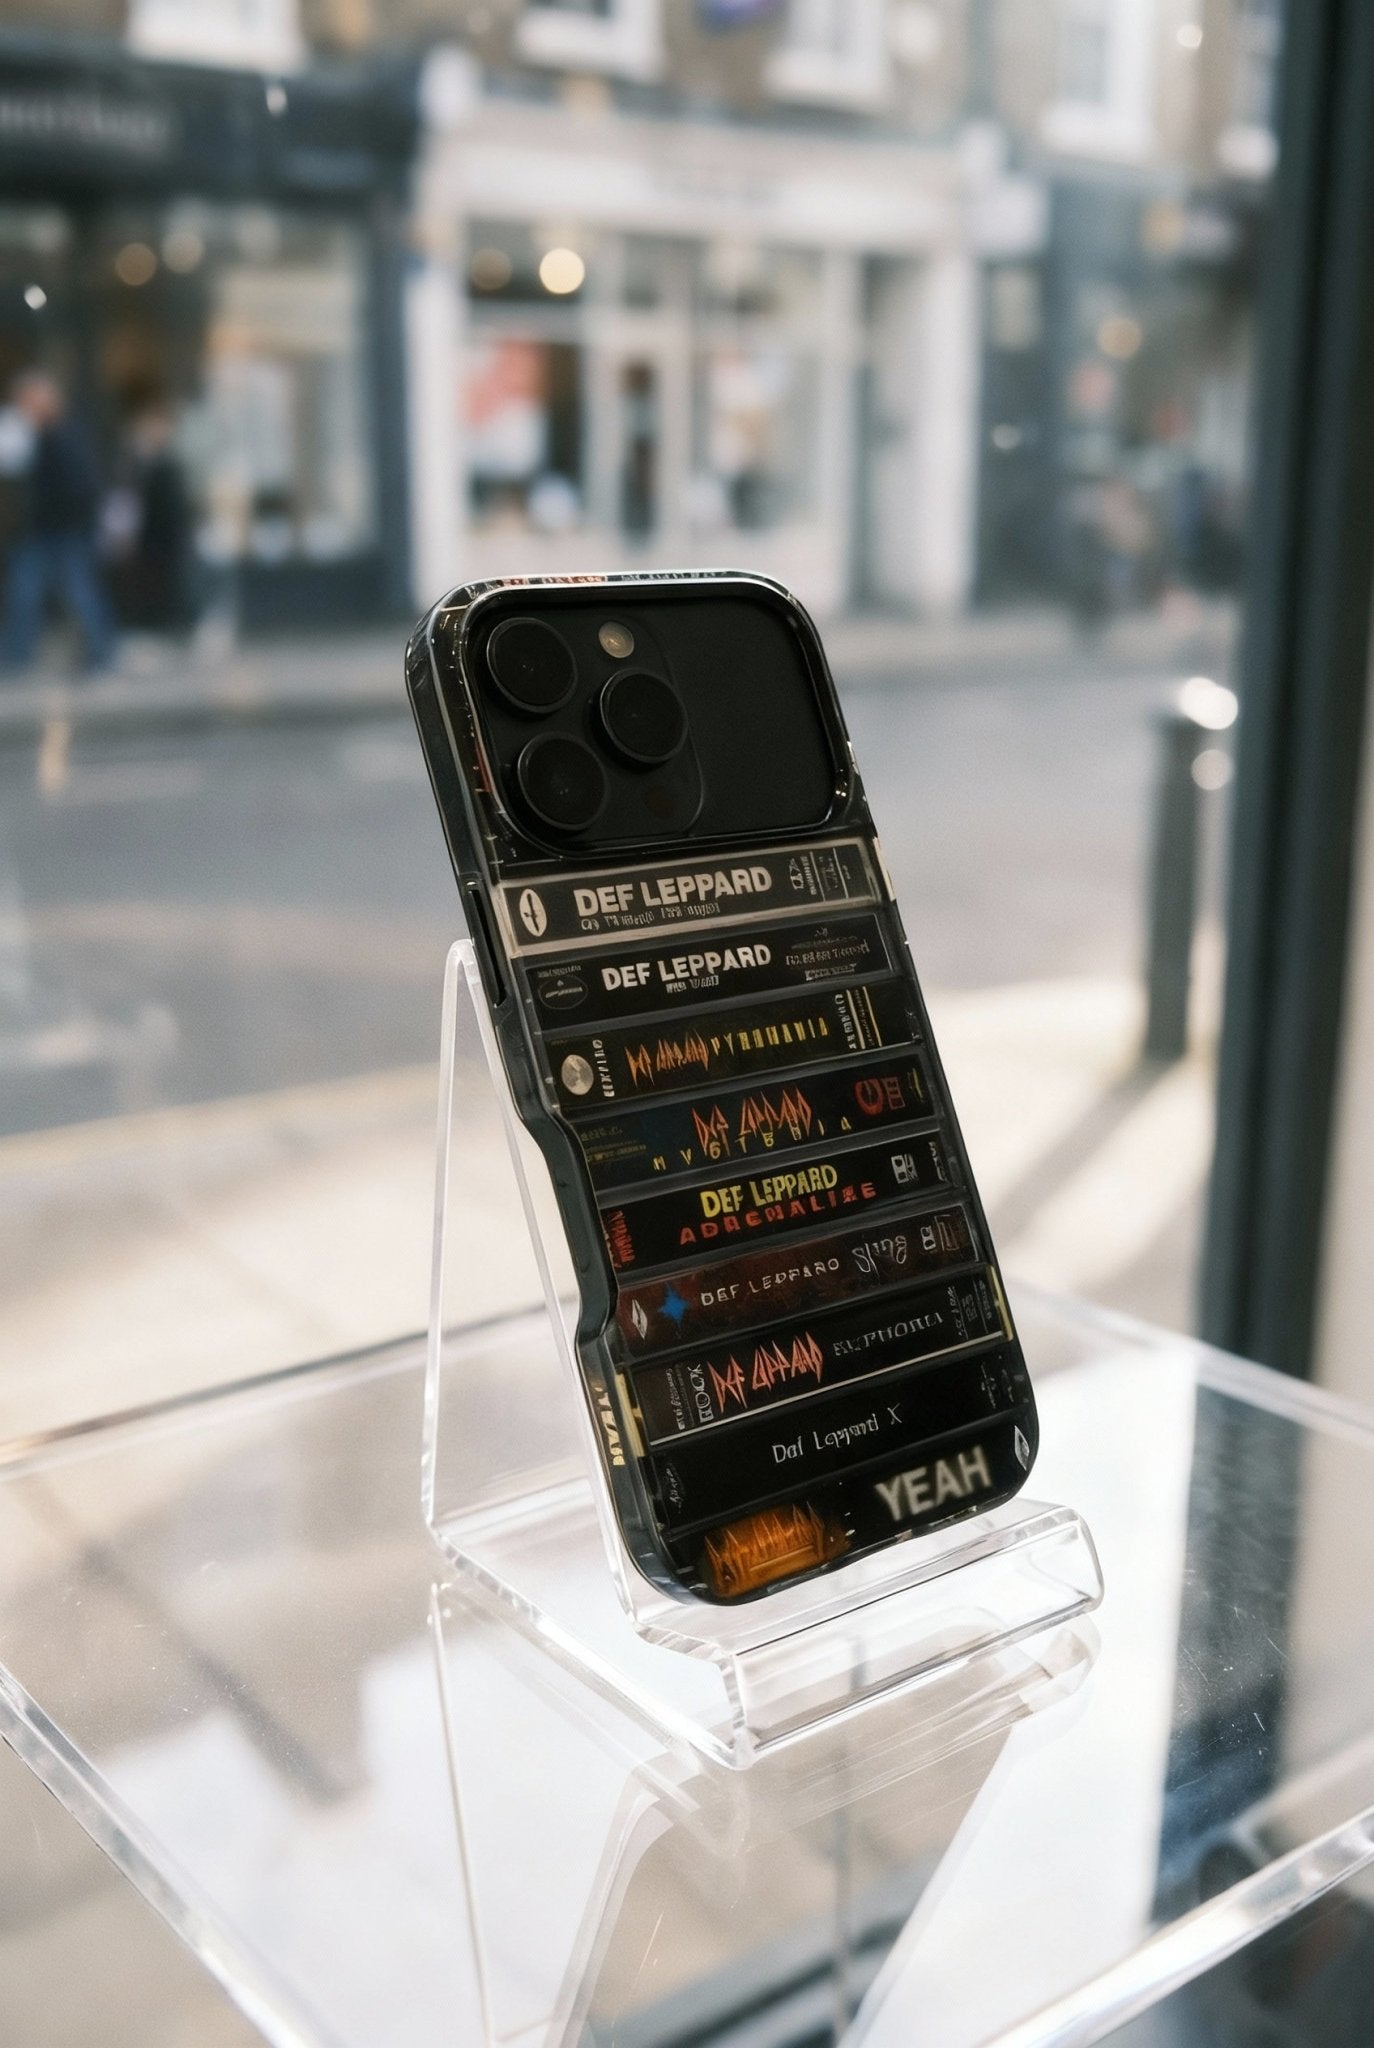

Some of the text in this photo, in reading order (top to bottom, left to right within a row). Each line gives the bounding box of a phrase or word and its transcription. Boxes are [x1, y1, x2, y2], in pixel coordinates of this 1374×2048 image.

[573, 883, 633, 917] DEF
[640, 866, 772, 907] LEPPARD
[601, 962, 650, 991] DEF
[657, 944, 771, 982] LEPPARD
[700, 1164, 838, 1218] DEF LEPPARD
[700, 1283, 740, 1306] DEF
[887, 1403, 902, 1426] X
[874, 1444, 993, 1522] YEAH
